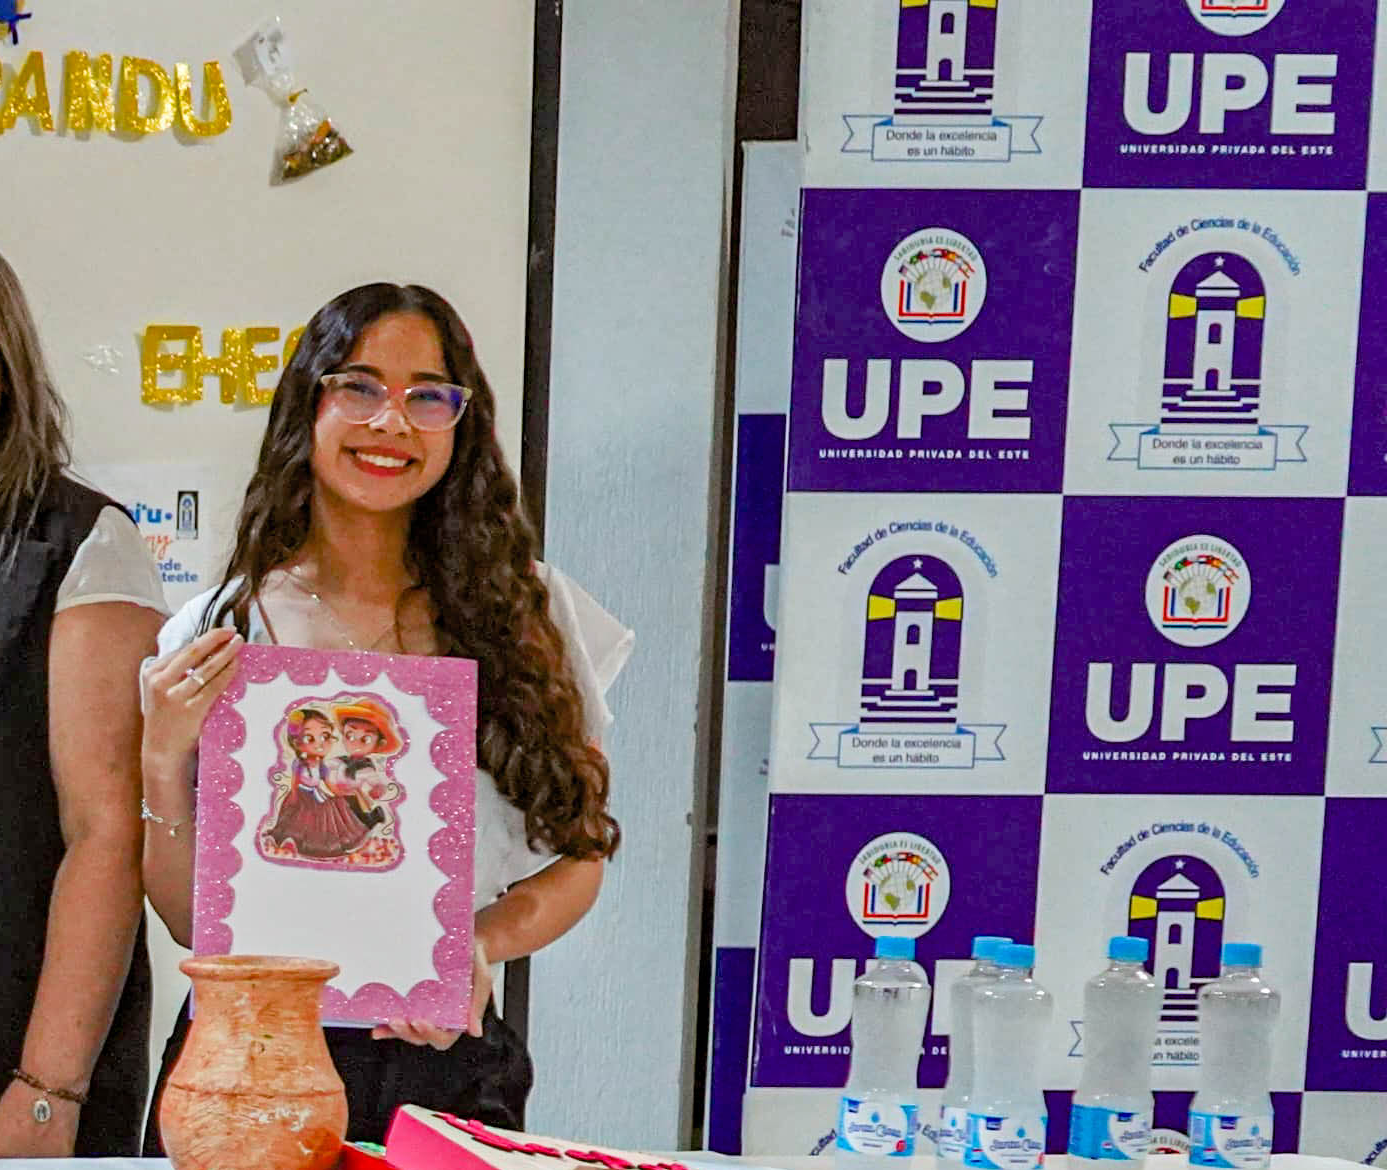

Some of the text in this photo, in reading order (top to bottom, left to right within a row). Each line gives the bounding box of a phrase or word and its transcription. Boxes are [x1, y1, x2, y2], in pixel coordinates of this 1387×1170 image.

[1123, 52, 1338, 135] UPE
[886, 129, 997, 142] Donde la excelencia
[907, 148, 921, 156] es
[923, 148, 937, 156] un
[1119, 144, 1333, 155] UNIVERSIDAD PRIVADA DEL ESTE
[1139, 217, 1301, 276] Facultad de Ciencias de la Educación
[821, 358, 1034, 440] UPE
[1153, 438, 1263, 450] Donde la excelencia
[819, 448, 1030, 460] UNIVERSIDAD PRIVADA DEL ESTE
[1172, 456, 1186, 465] es
[1189, 456, 1203, 465] un
[838, 520, 997, 578] Facultad de Ciencias de la Educación
[1085, 662, 1297, 743] UPE
[852, 737, 961, 749] Donde la excelencia
[872, 756, 885, 764] es
[889, 755, 903, 763] un
[1083, 751, 1292, 762] UNIVERSIDAD PRIVADA DEL ESTE
[1100, 820, 1259, 879] Facultad de Ciencias de la Educación
